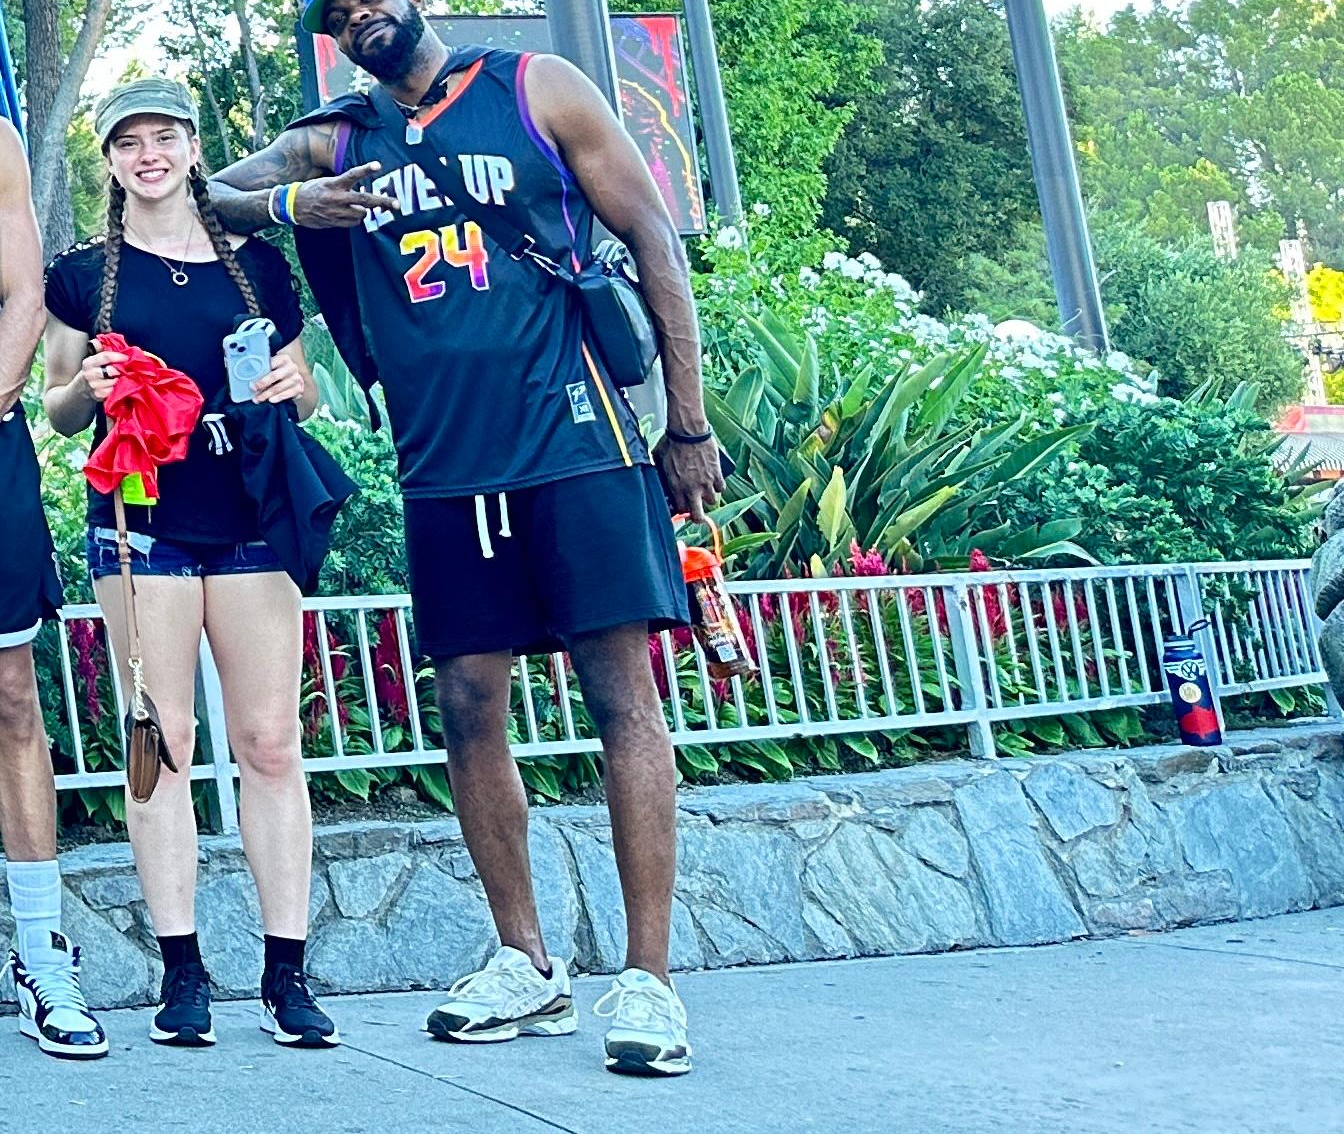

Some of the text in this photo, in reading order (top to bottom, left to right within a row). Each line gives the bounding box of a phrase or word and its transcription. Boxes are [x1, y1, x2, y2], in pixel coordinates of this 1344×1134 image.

[360, 154, 515, 233] LEVE UP
[400, 221, 490, 303] 24
